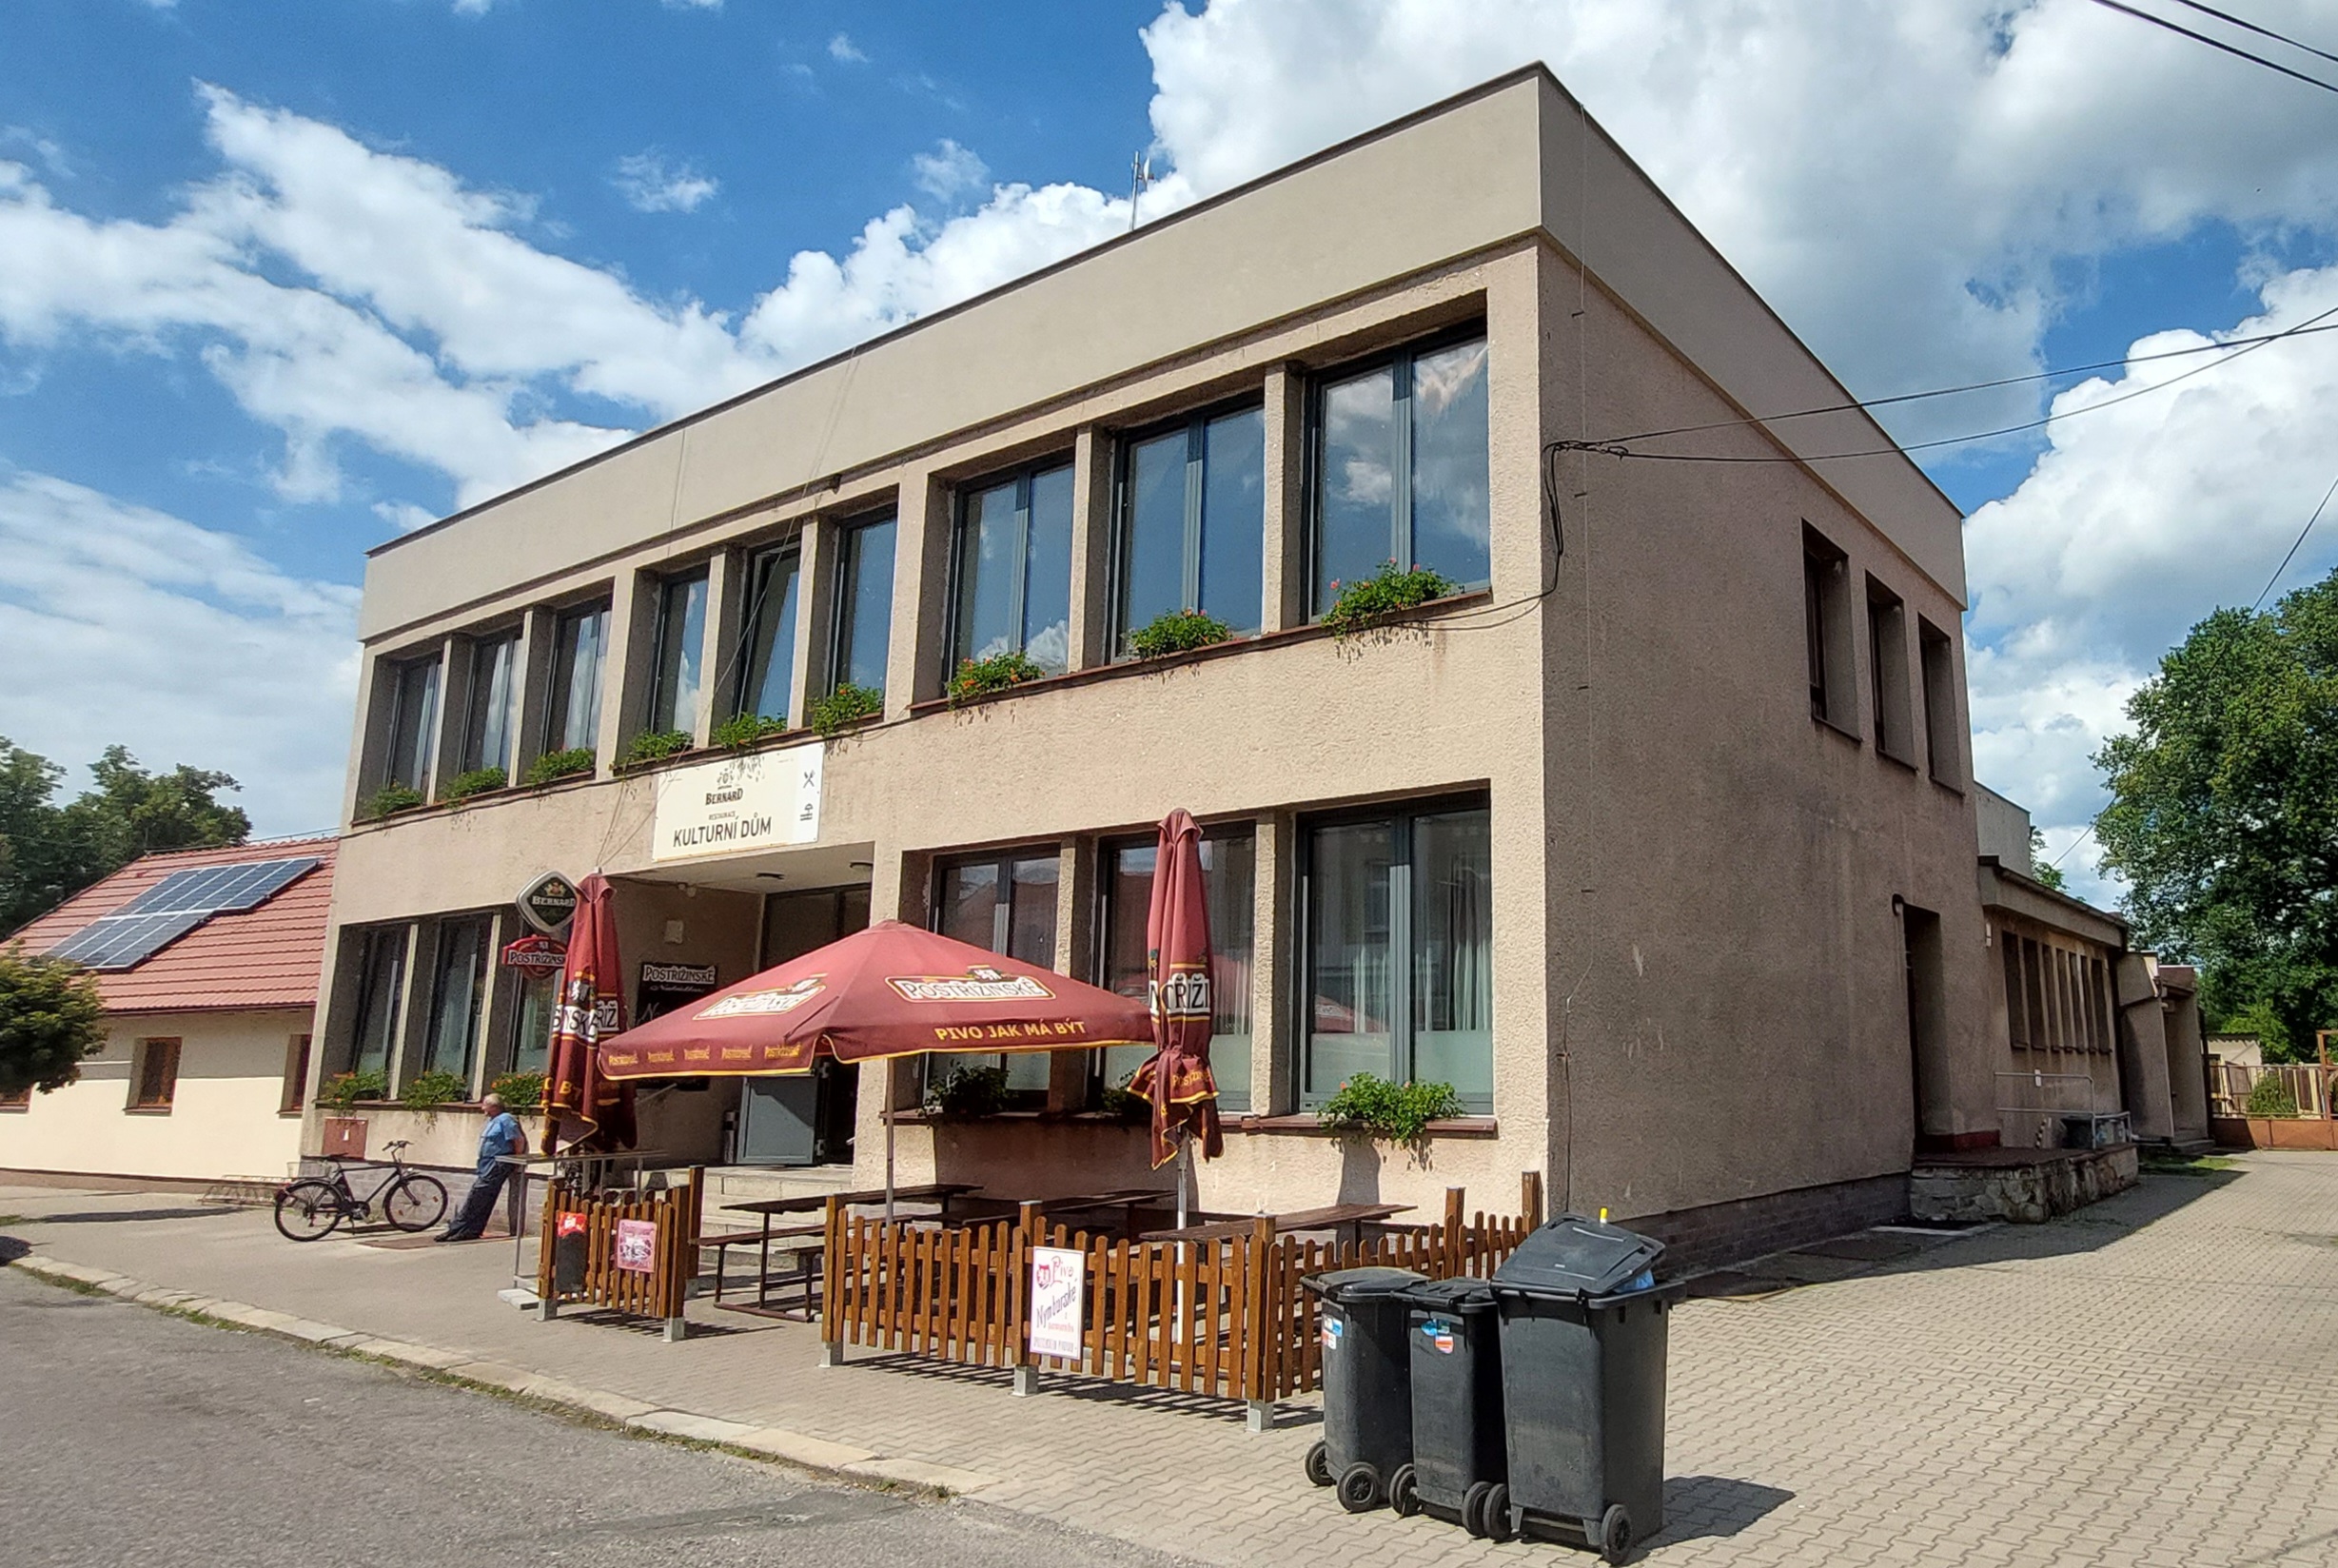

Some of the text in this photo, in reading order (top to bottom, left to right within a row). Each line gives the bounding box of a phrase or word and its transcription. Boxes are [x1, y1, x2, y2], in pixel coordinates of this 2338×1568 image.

[705, 788, 743, 806] BERNARD
[673, 812, 772, 847] KULTURNÍ DŮM
[532, 895, 576, 908] BERNARD
[903, 978, 1043, 997] POSTŘIŽINSKÉ
[933, 1017, 1087, 1041] PIVO JAK MÁ BÝT
[1050, 1255, 1074, 1286] Pivo
